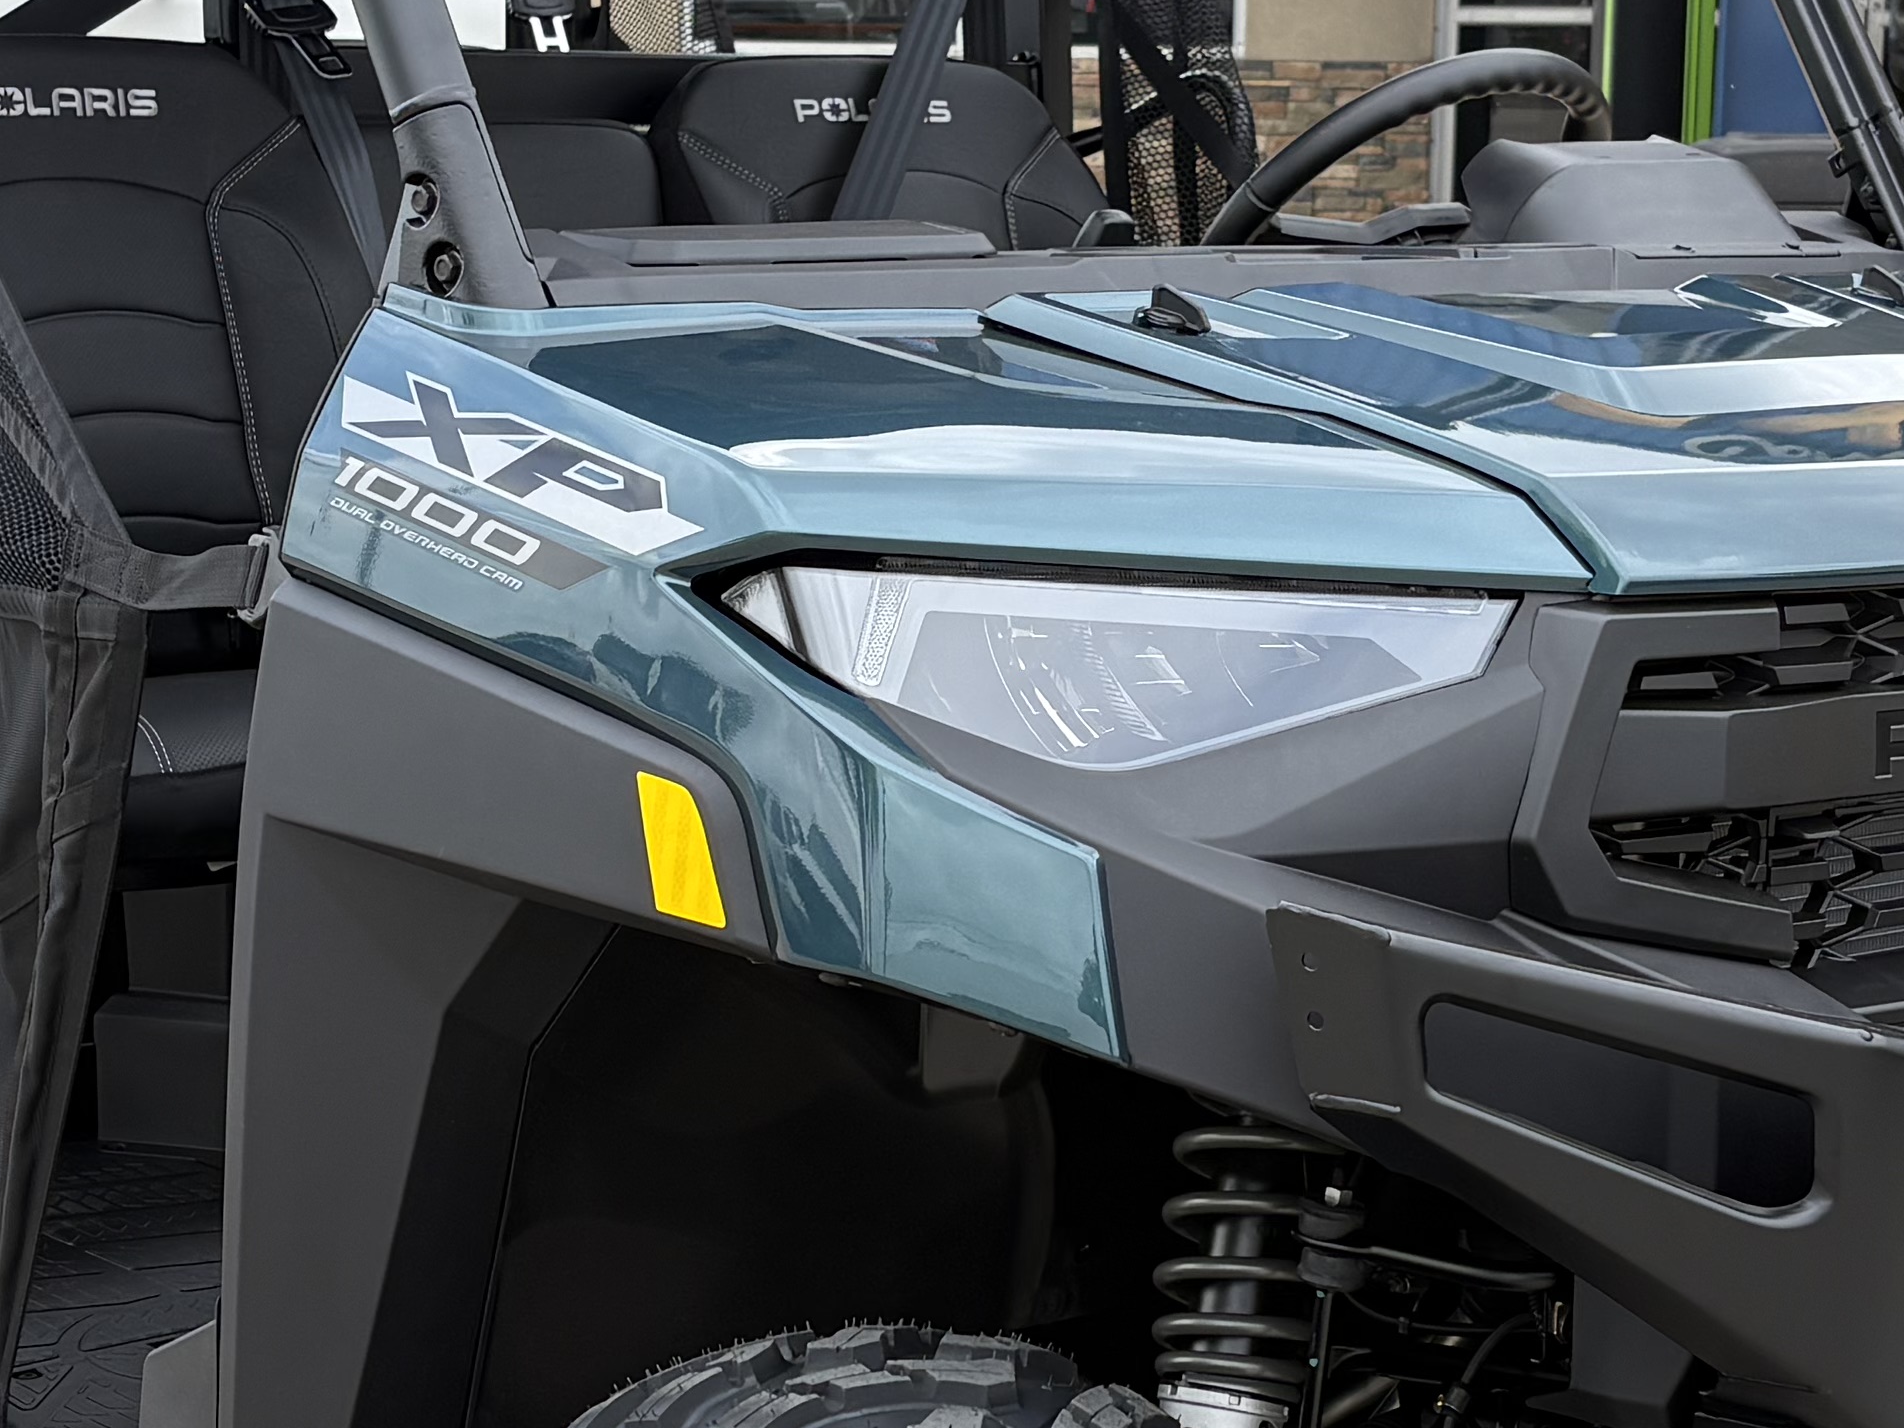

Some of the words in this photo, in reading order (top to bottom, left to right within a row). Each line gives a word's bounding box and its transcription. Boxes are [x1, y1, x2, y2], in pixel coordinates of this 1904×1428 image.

[793, 97, 952, 124] POLS
[343, 371, 670, 515] XP
[329, 495, 377, 526] DUAL
[380, 517, 480, 577] OVERHEAD
[478, 562, 526, 592] CAM
[334, 456, 542, 568] 1000
